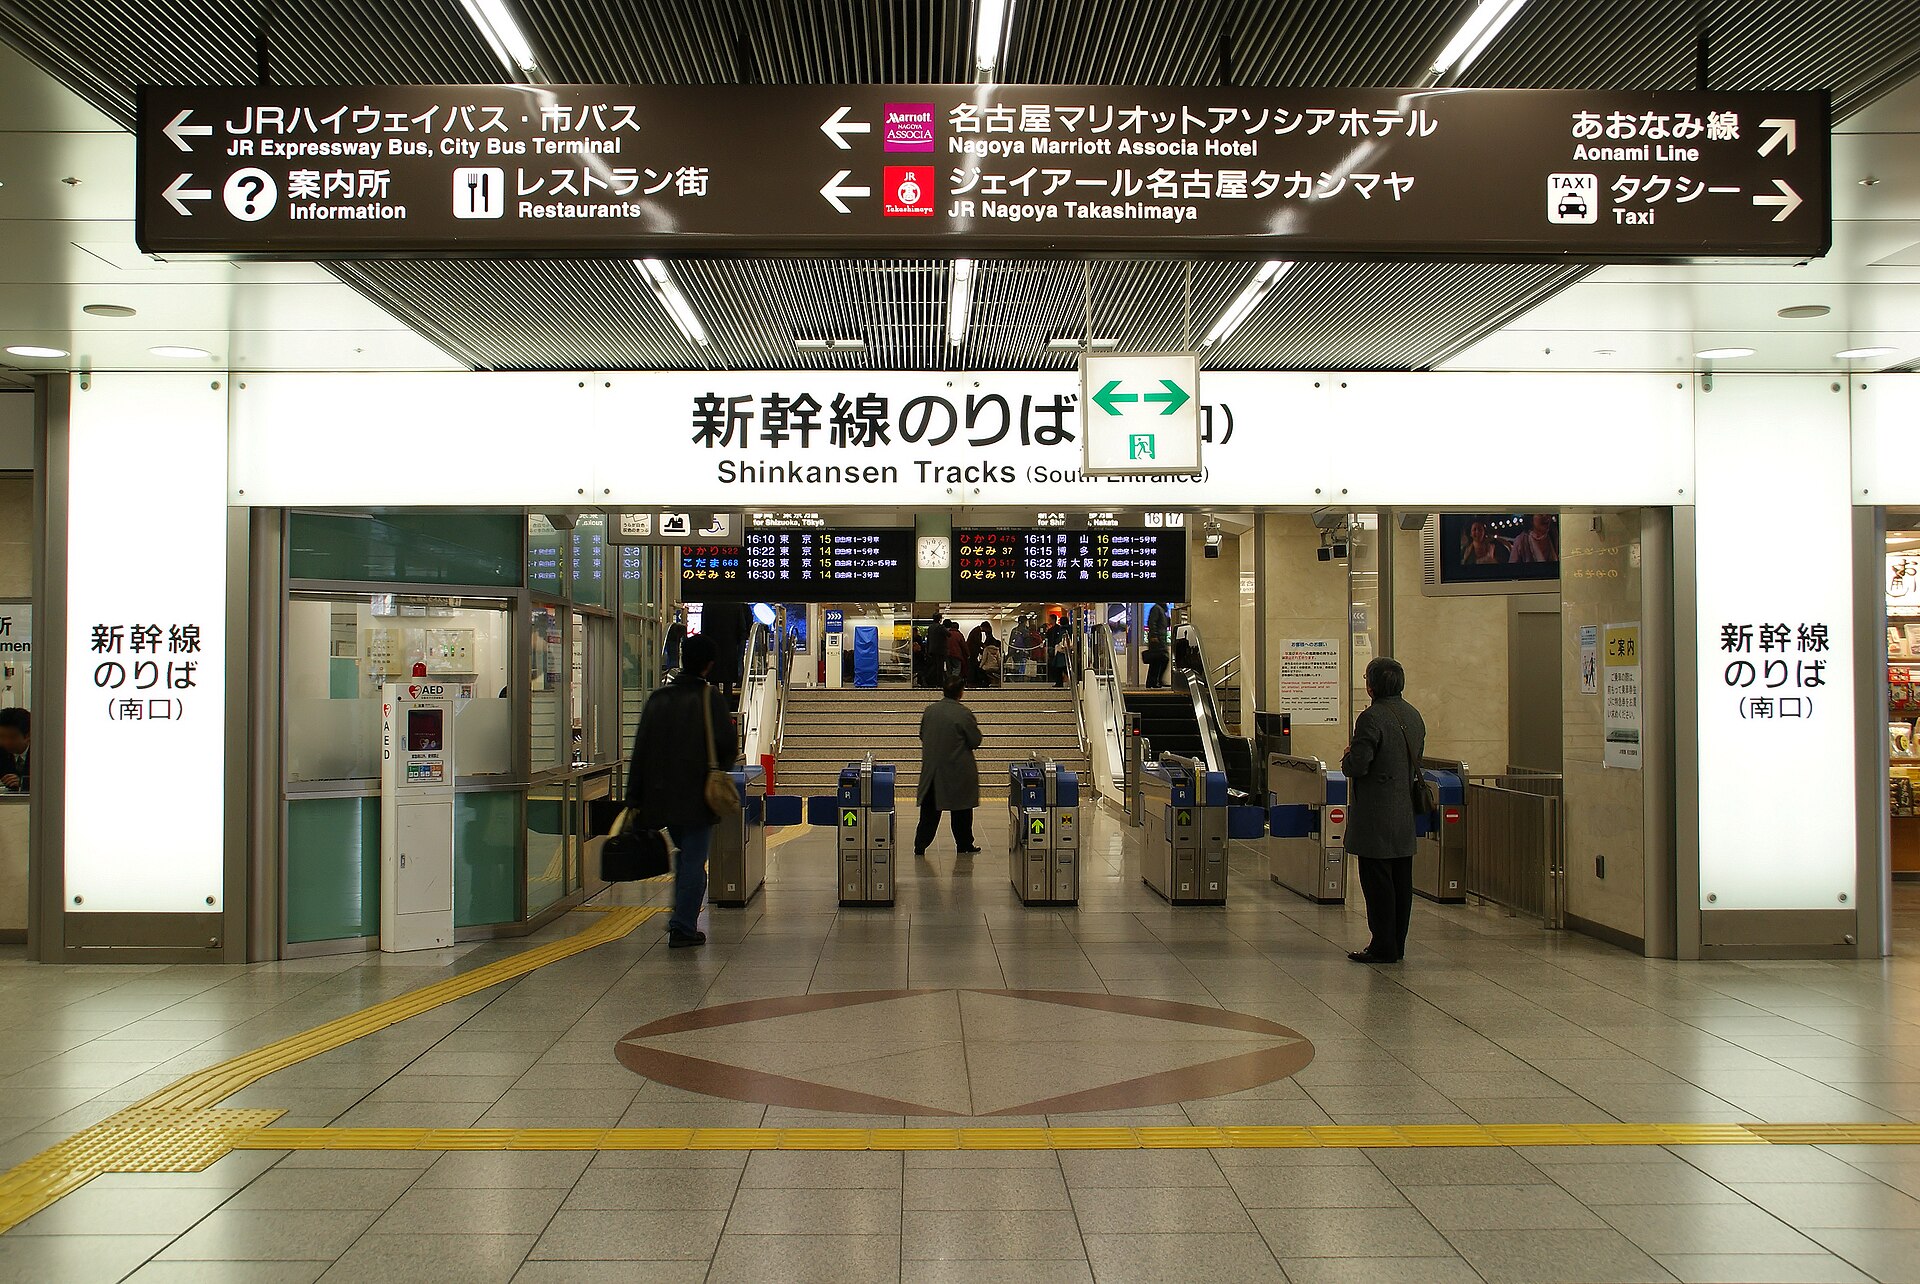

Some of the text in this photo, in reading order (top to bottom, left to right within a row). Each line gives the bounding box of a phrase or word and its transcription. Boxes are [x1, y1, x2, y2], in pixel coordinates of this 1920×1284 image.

[886, 112, 932, 123] Marriott
[948, 103, 1439, 138] 名古屋マリオットアソシアホテル
[1571, 110, 1740, 141] あおなみ線
[887, 129, 933, 139] ASSOCIA
[227, 138, 621, 159] JR Expressway Bus, City Bus Terminal
[949, 137, 1258, 158] Nagoya Marriott Associa Hotel
[1572, 144, 1700, 162] Aonami Line
[287, 169, 391, 199] 案内所
[516, 166, 709, 196] レストラン街
[903, 171, 916, 181] JR
[949, 167, 1415, 201] ジェイアール名古屋タカシマヤ
[1552, 177, 1591, 189] TAXI
[1610, 174, 1740, 204] タクシー
[290, 202, 406, 220] Information
[518, 202, 641, 219] Restaurants
[948, 201, 1198, 222] JR Nagoya Takashimaya
[1612, 208, 1655, 225] Taxi
[718, 461, 897, 484] Shinkansen
[913, 461, 1016, 484] Tracks
[746, 534, 775, 544] 16:10
[819, 534, 832, 544] 15
[960, 534, 997, 545] ひかり
[1024, 534, 1052, 544] 16:11
[1096, 534, 1110, 544] 16
[682, 545, 719, 556] ひかり
[746, 546, 775, 556] 16:22
[819, 546, 832, 556] 14
[960, 546, 997, 556] のぞみ
[1002, 547, 1013, 555] 37
[1024, 546, 1053, 556] 16:15
[1096, 546, 1110, 556] 17
[682, 558, 720, 568] こだま
[722, 559, 739, 567] 668
[746, 558, 775, 568] 16:28
[819, 558, 832, 568] 15
[1023, 558, 1053, 568] 16:22
[1096, 558, 1110, 568] 17
[682, 569, 720, 580] のぞみ
[724, 571, 736, 579] 32
[746, 570, 776, 580] 16:30
[819, 570, 832, 580] 14
[960, 570, 997, 580] のぞみ
[1023, 570, 1053, 580] 16:35
[1096, 570, 1110, 580] 16
[90, 623, 202, 654] 新幹線
[1720, 622, 1830, 653] 新幹線
[1608, 637, 1636, 657] ご案内
[94, 660, 198, 690] のりば
[1724, 659, 1827, 689] のりば
[421, 685, 444, 695] AED
